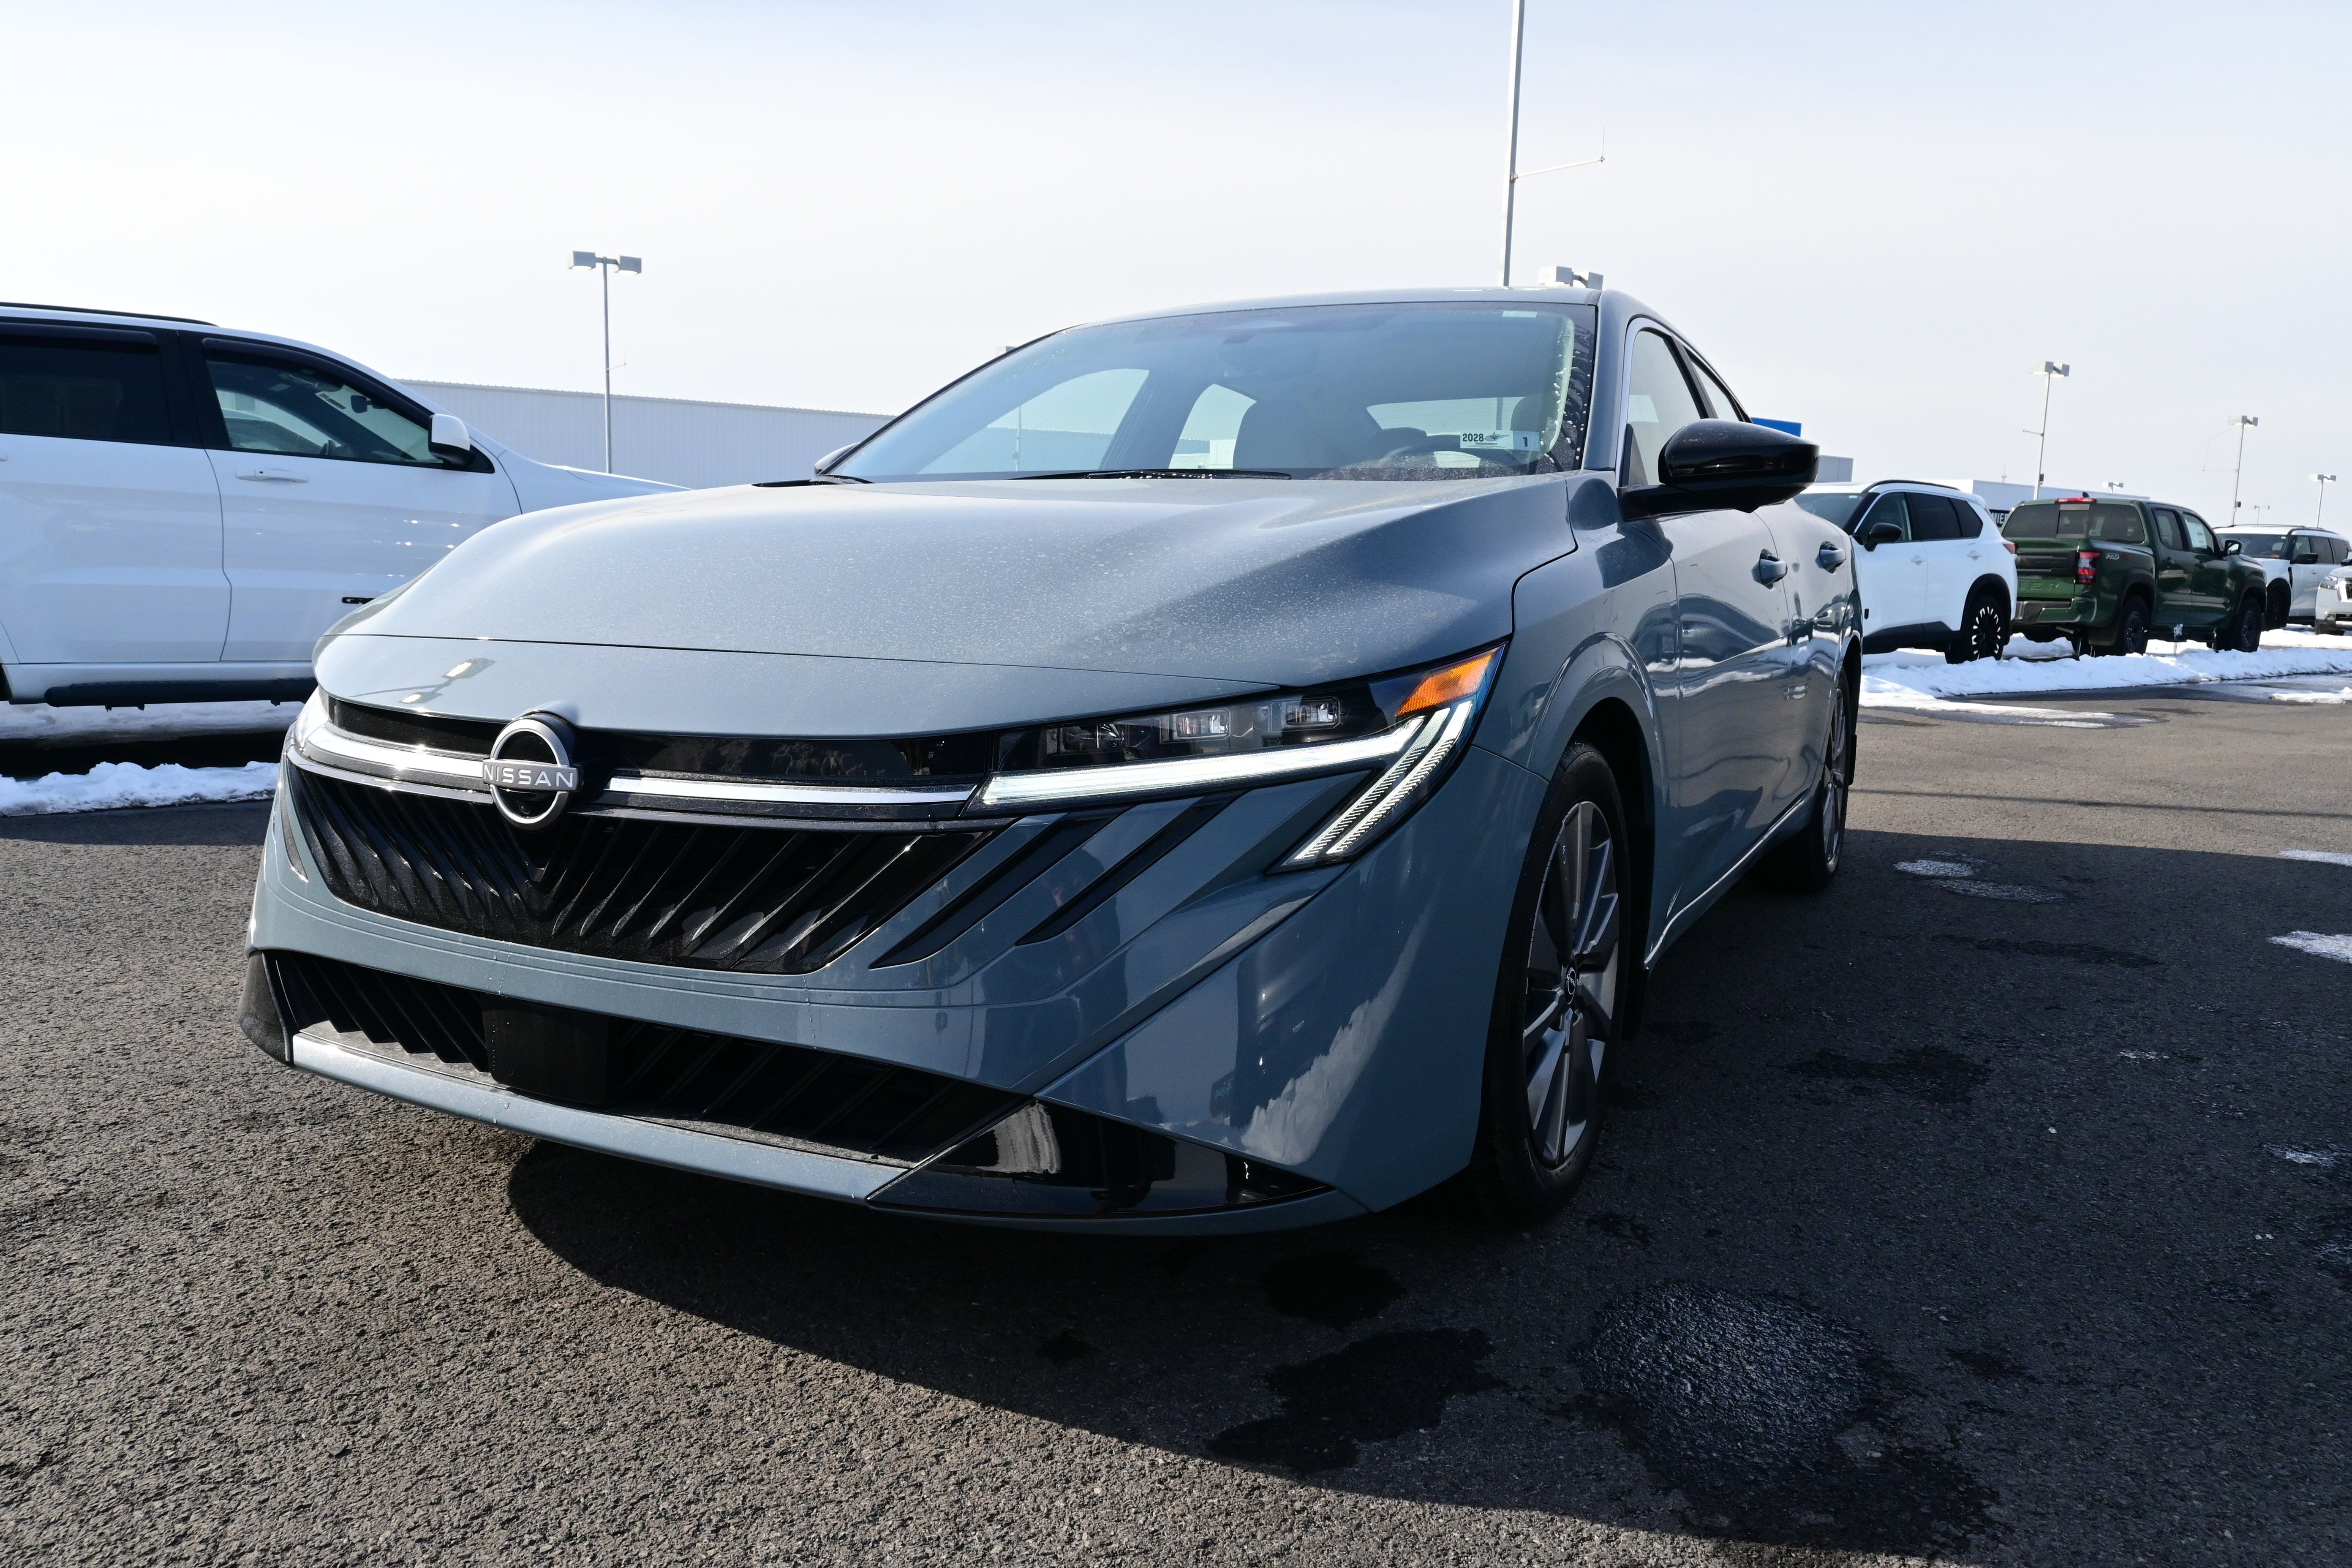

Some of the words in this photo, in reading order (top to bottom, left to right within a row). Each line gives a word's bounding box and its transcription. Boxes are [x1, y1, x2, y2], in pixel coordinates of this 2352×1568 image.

[1462, 433, 1484, 442] 2028
[1523, 437, 1528, 447] 1
[483, 764, 573, 787] NISSAN
